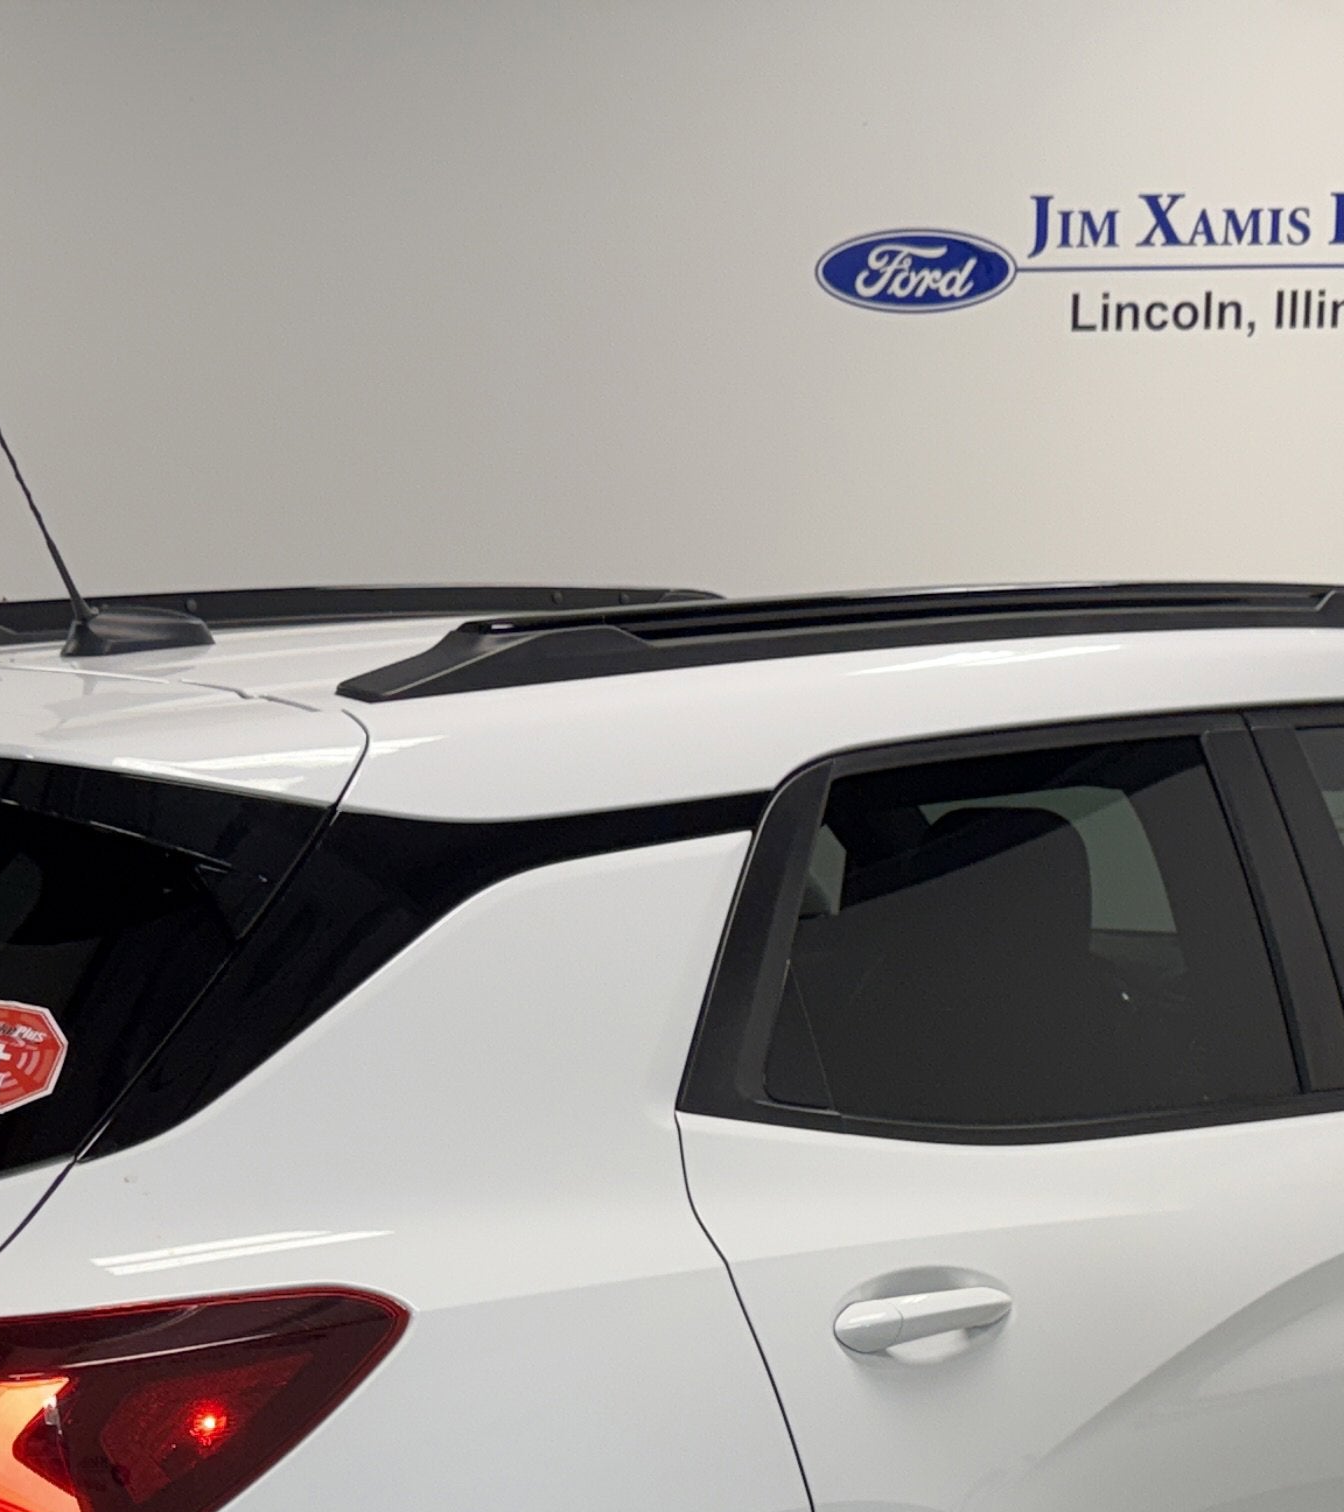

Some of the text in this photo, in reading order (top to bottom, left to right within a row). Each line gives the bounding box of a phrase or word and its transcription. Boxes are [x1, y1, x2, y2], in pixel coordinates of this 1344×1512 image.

[1026, 194, 1120, 260] JIM
[1135, 193, 1311, 248] XAMIS
[855, 243, 977, 299] Ford
[1070, 290, 1256, 338] Lincoln,
